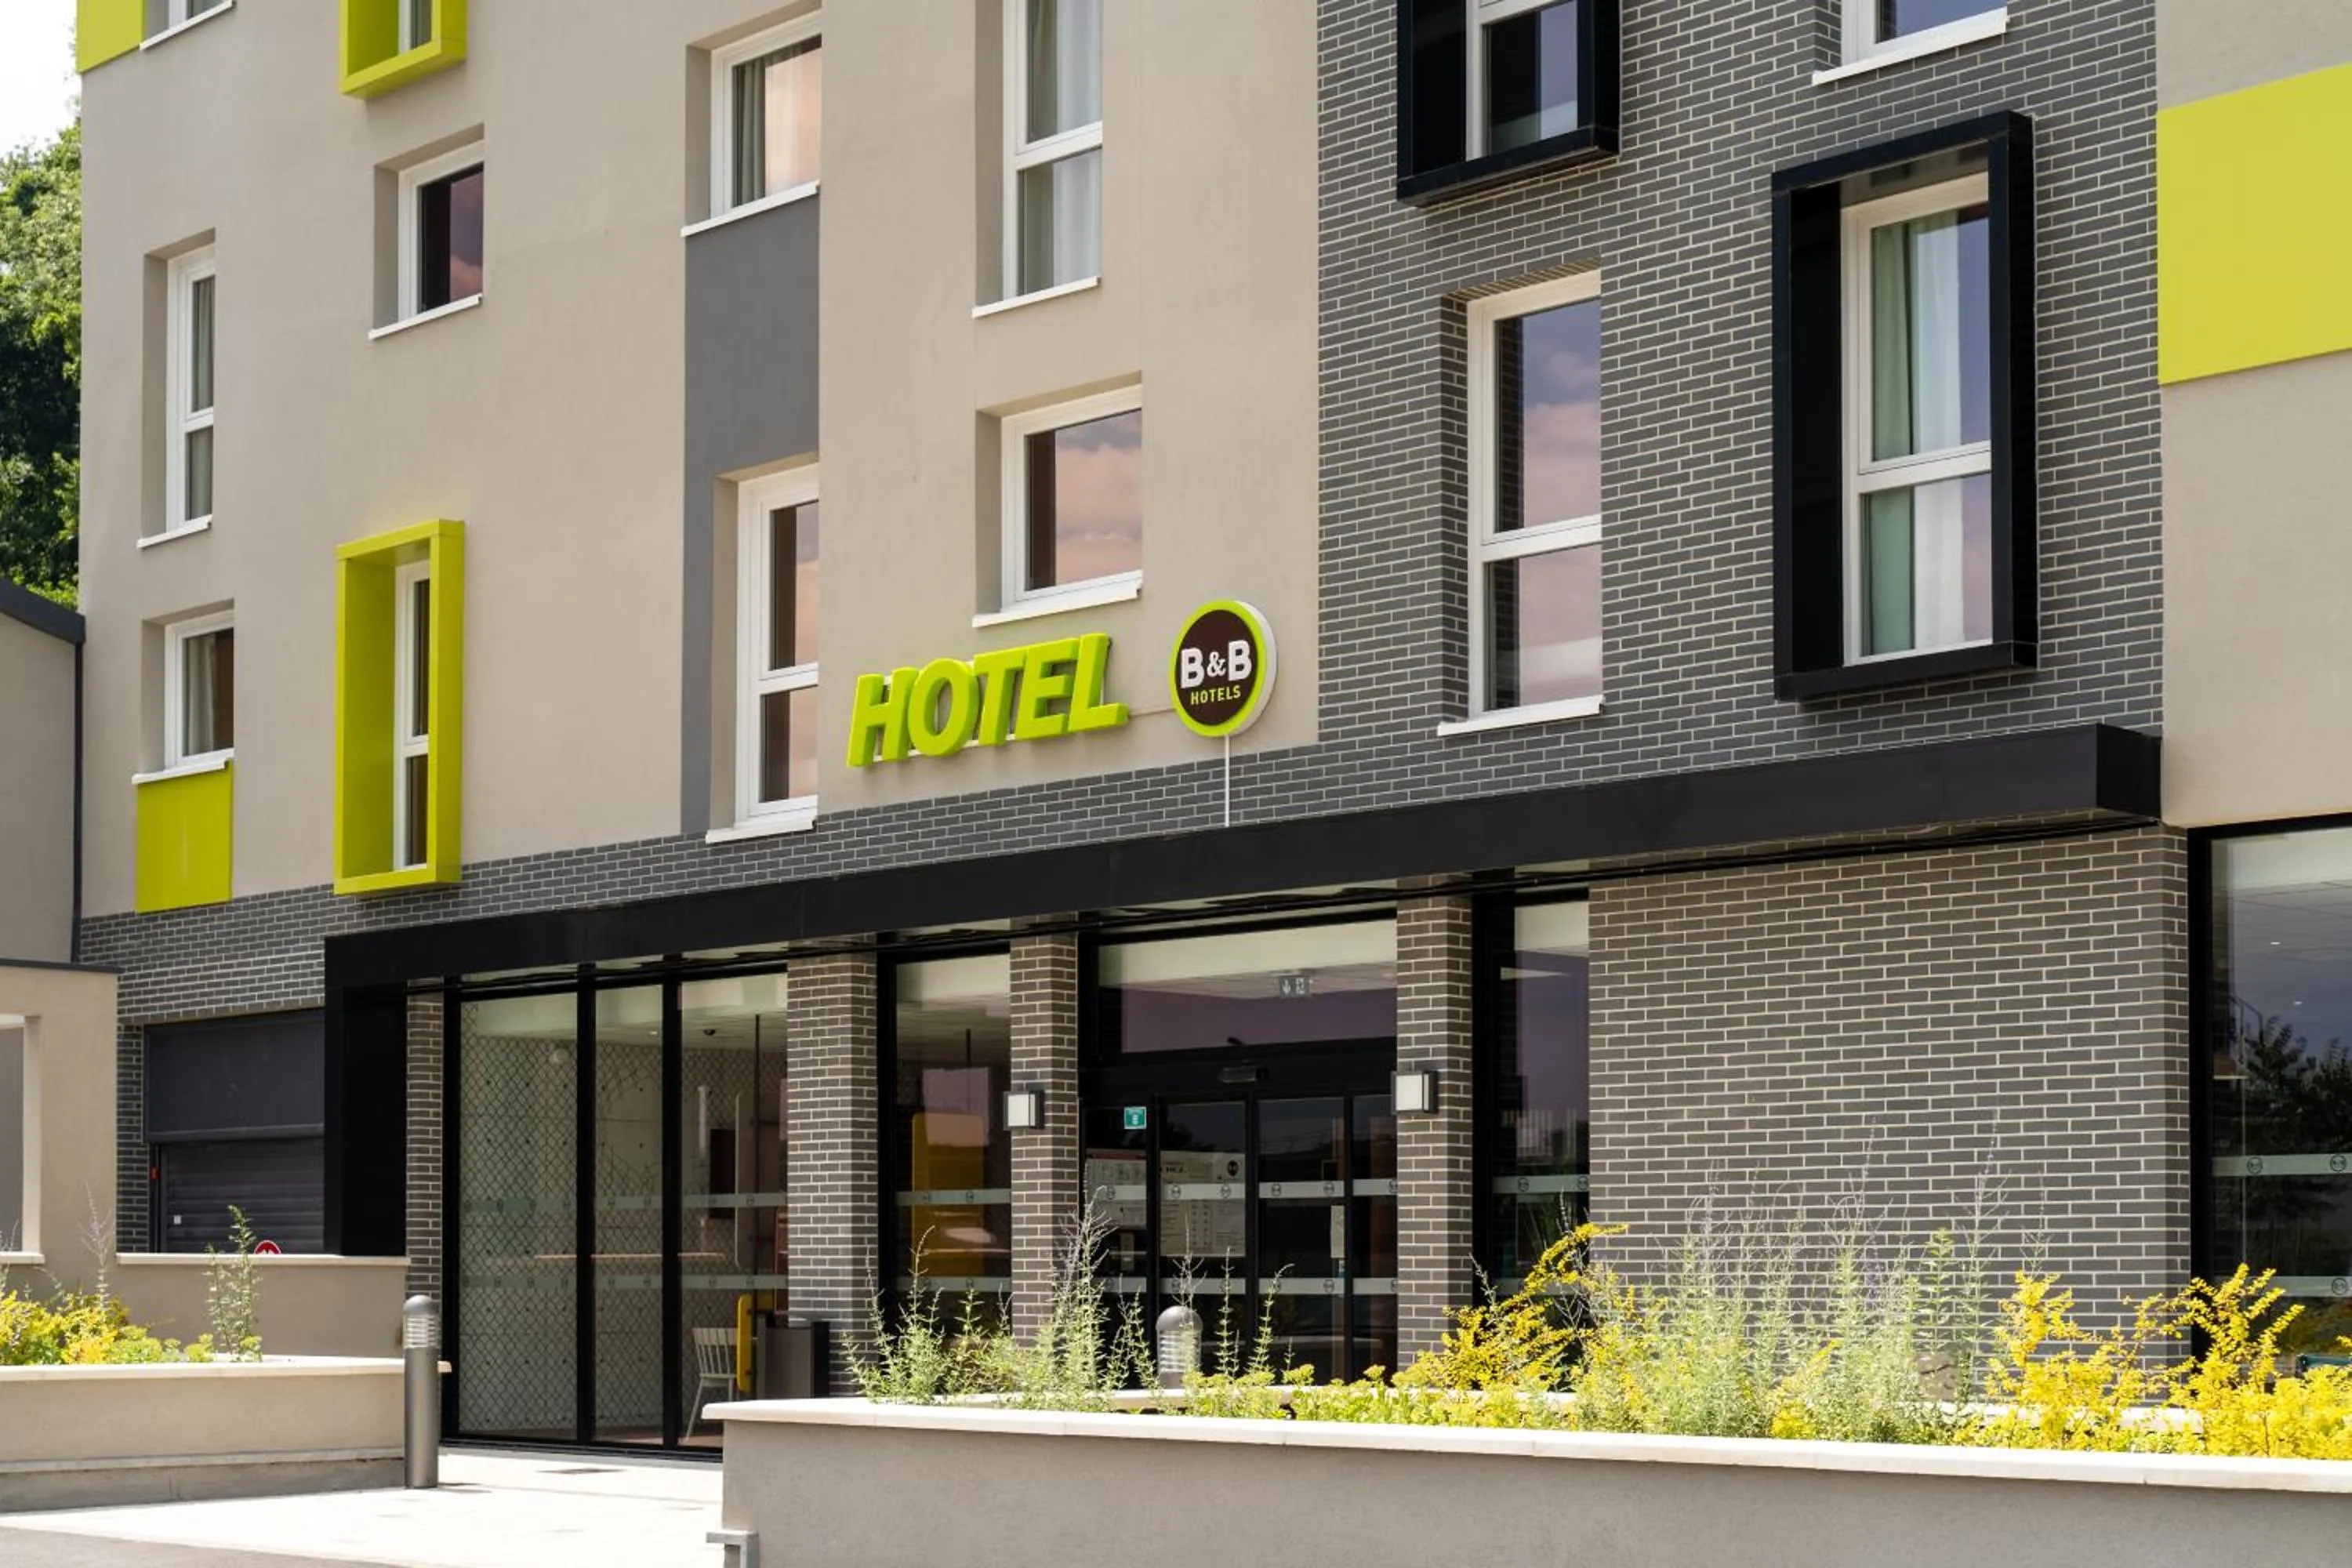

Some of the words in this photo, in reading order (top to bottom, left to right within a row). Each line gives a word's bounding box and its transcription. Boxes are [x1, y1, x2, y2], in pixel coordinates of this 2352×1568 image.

[1181, 640, 1252, 688] B&B
[848, 633, 1129, 767] HOTEL
[1190, 685, 1241, 706] HOTELS
